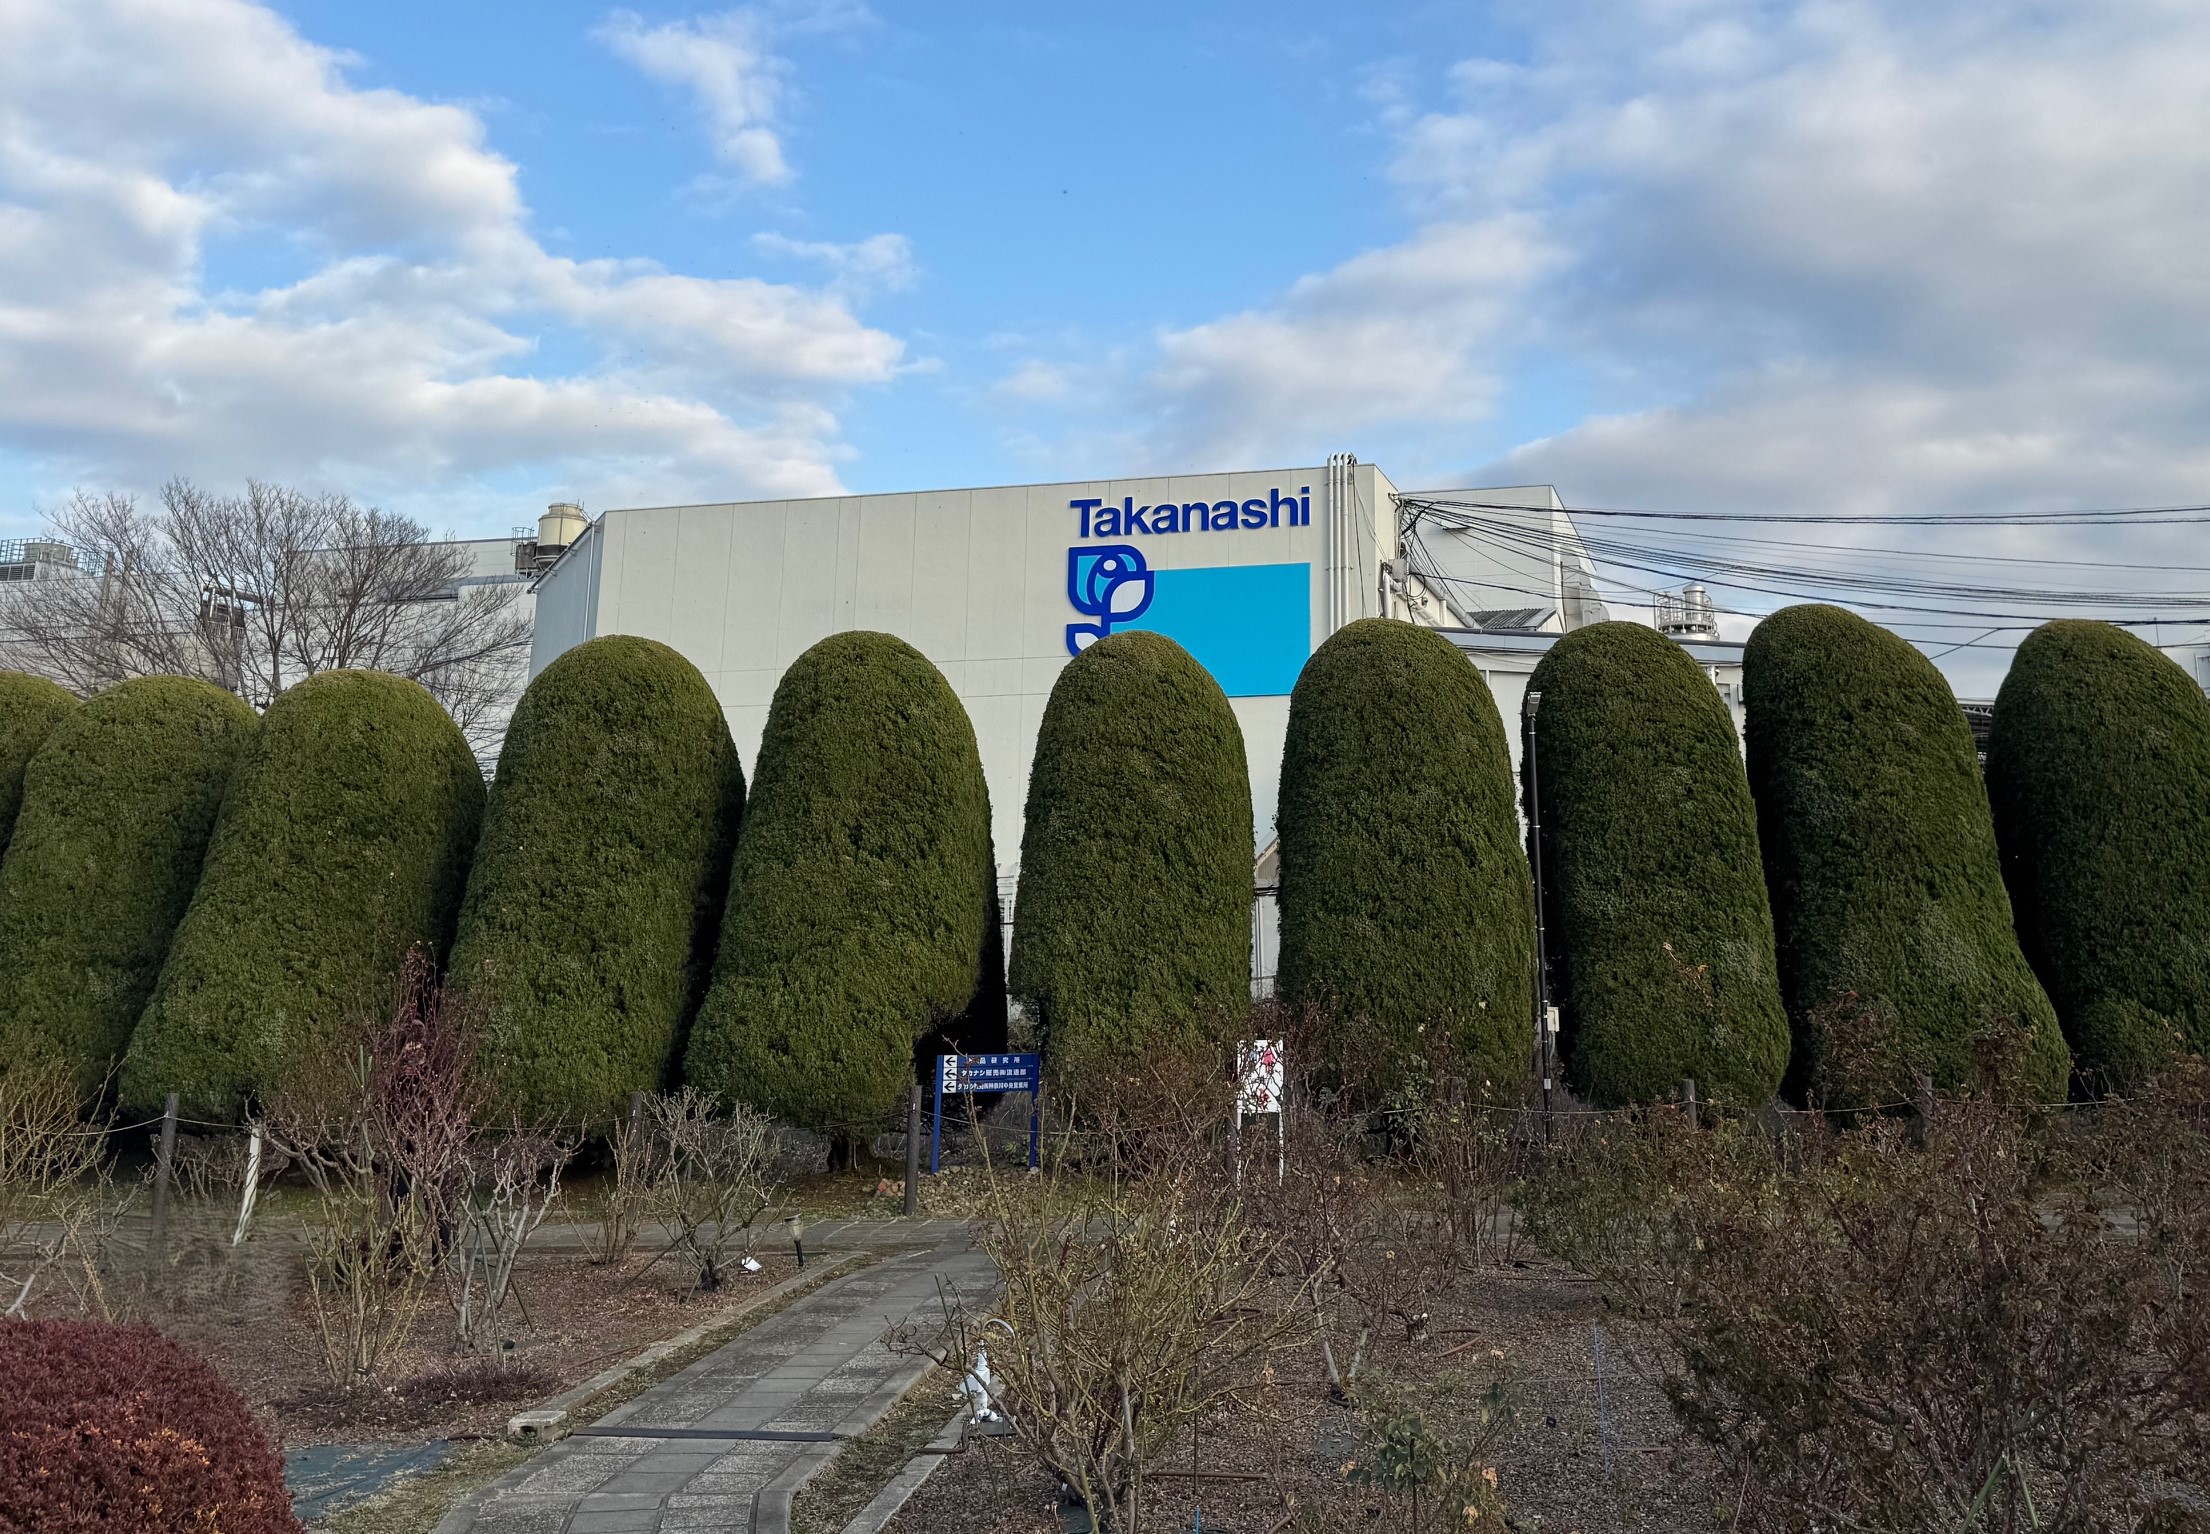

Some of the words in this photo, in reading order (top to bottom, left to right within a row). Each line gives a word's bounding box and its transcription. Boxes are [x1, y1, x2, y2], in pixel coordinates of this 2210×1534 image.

[1070, 486, 1310, 538] Takanashi
[968, 1056, 1020, 1065] 品研究所
